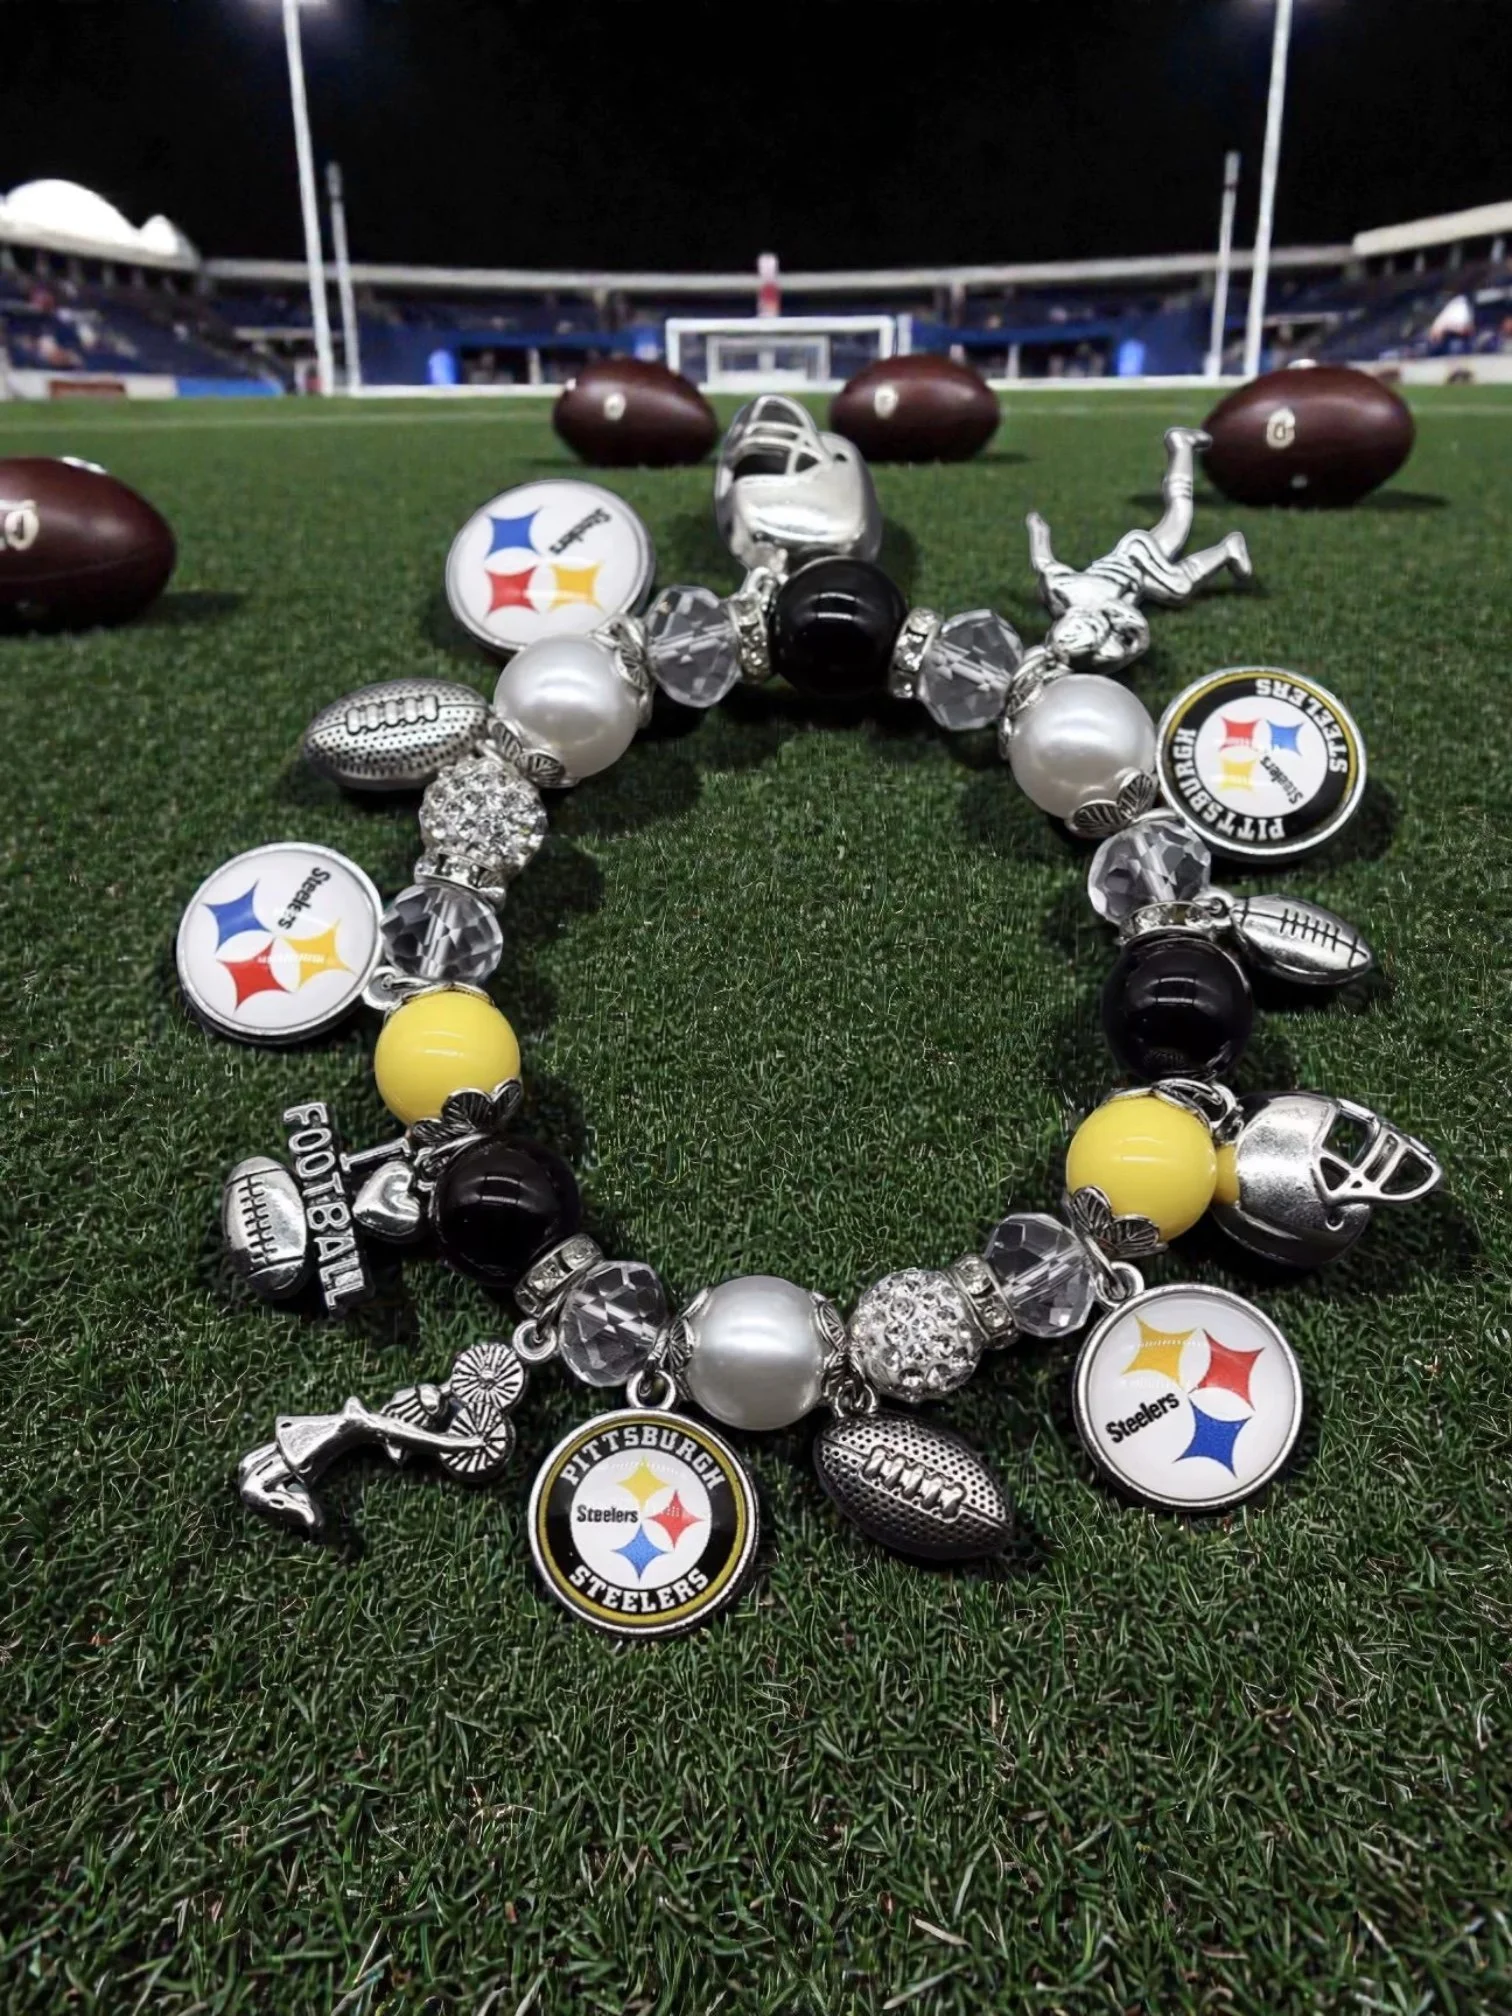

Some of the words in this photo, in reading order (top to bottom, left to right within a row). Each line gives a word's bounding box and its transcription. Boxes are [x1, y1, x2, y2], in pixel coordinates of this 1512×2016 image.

[1255, 679, 1347, 773] STEELERS
[1172, 728, 1286, 840] PITTSBURGH
[1260, 756, 1303, 804] Steelers
[283, 1102, 366, 1309] FOOTBALL
[1105, 1393, 1180, 1443] Steelers
[560, 1426, 726, 1489] PITTSBURGH
[576, 1504, 639, 1523] Steelers
[569, 1565, 709, 1612] STEELERS
